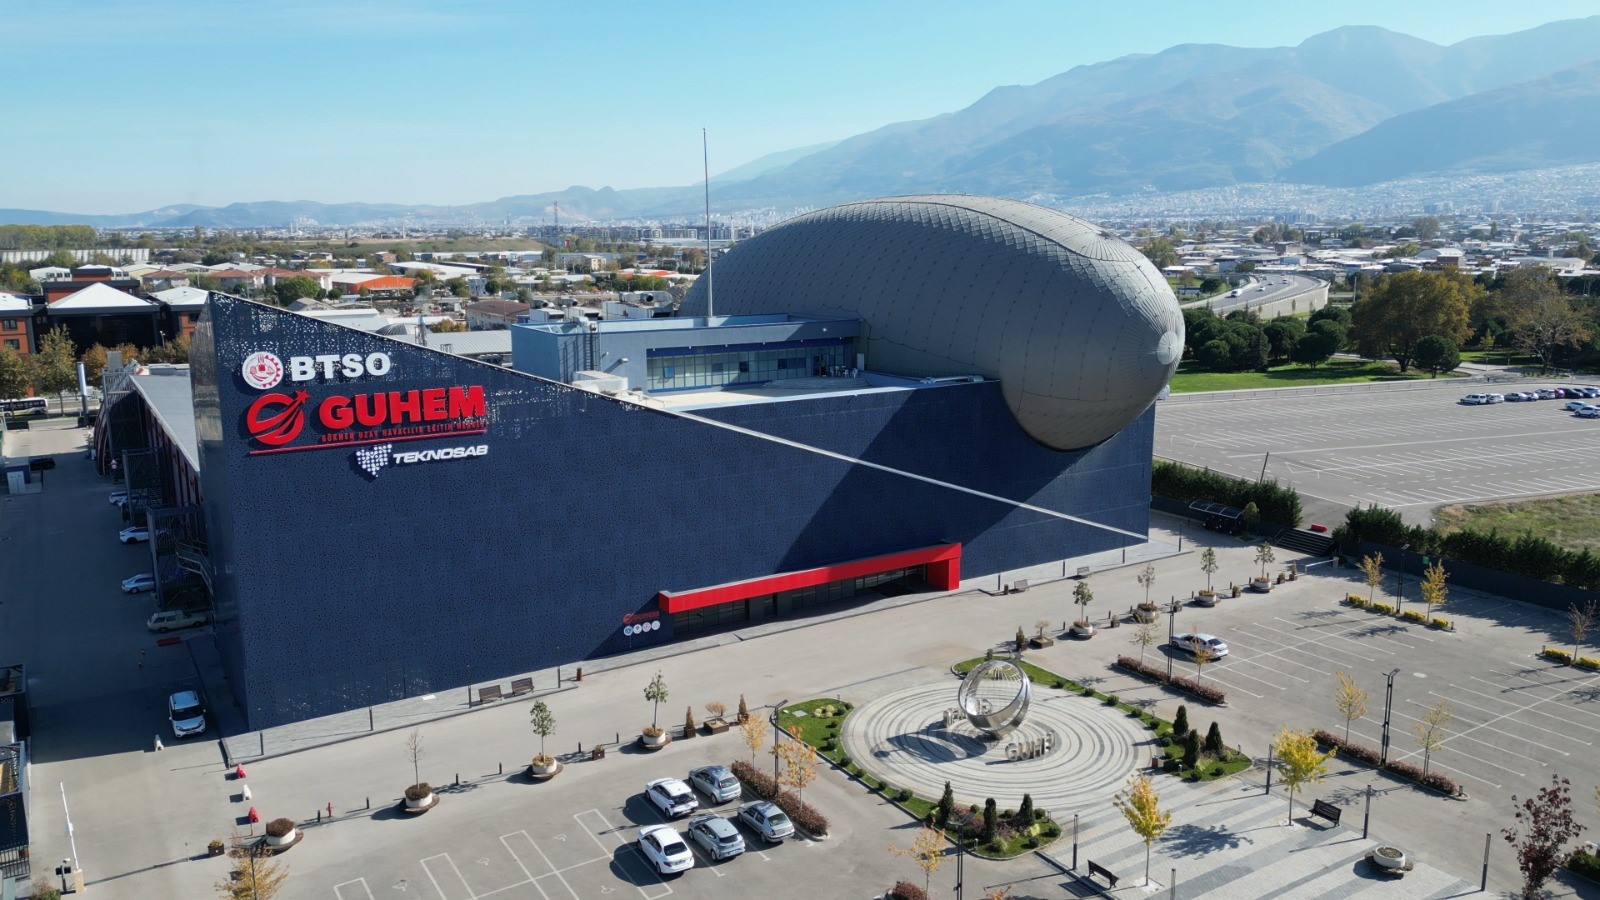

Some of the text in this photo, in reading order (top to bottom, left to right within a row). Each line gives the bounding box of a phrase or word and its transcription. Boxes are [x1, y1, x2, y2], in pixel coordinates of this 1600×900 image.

[290, 352, 391, 382] BTSO
[319, 385, 486, 430] GUHEM
[392, 444, 488, 465] TEKNOSAB
